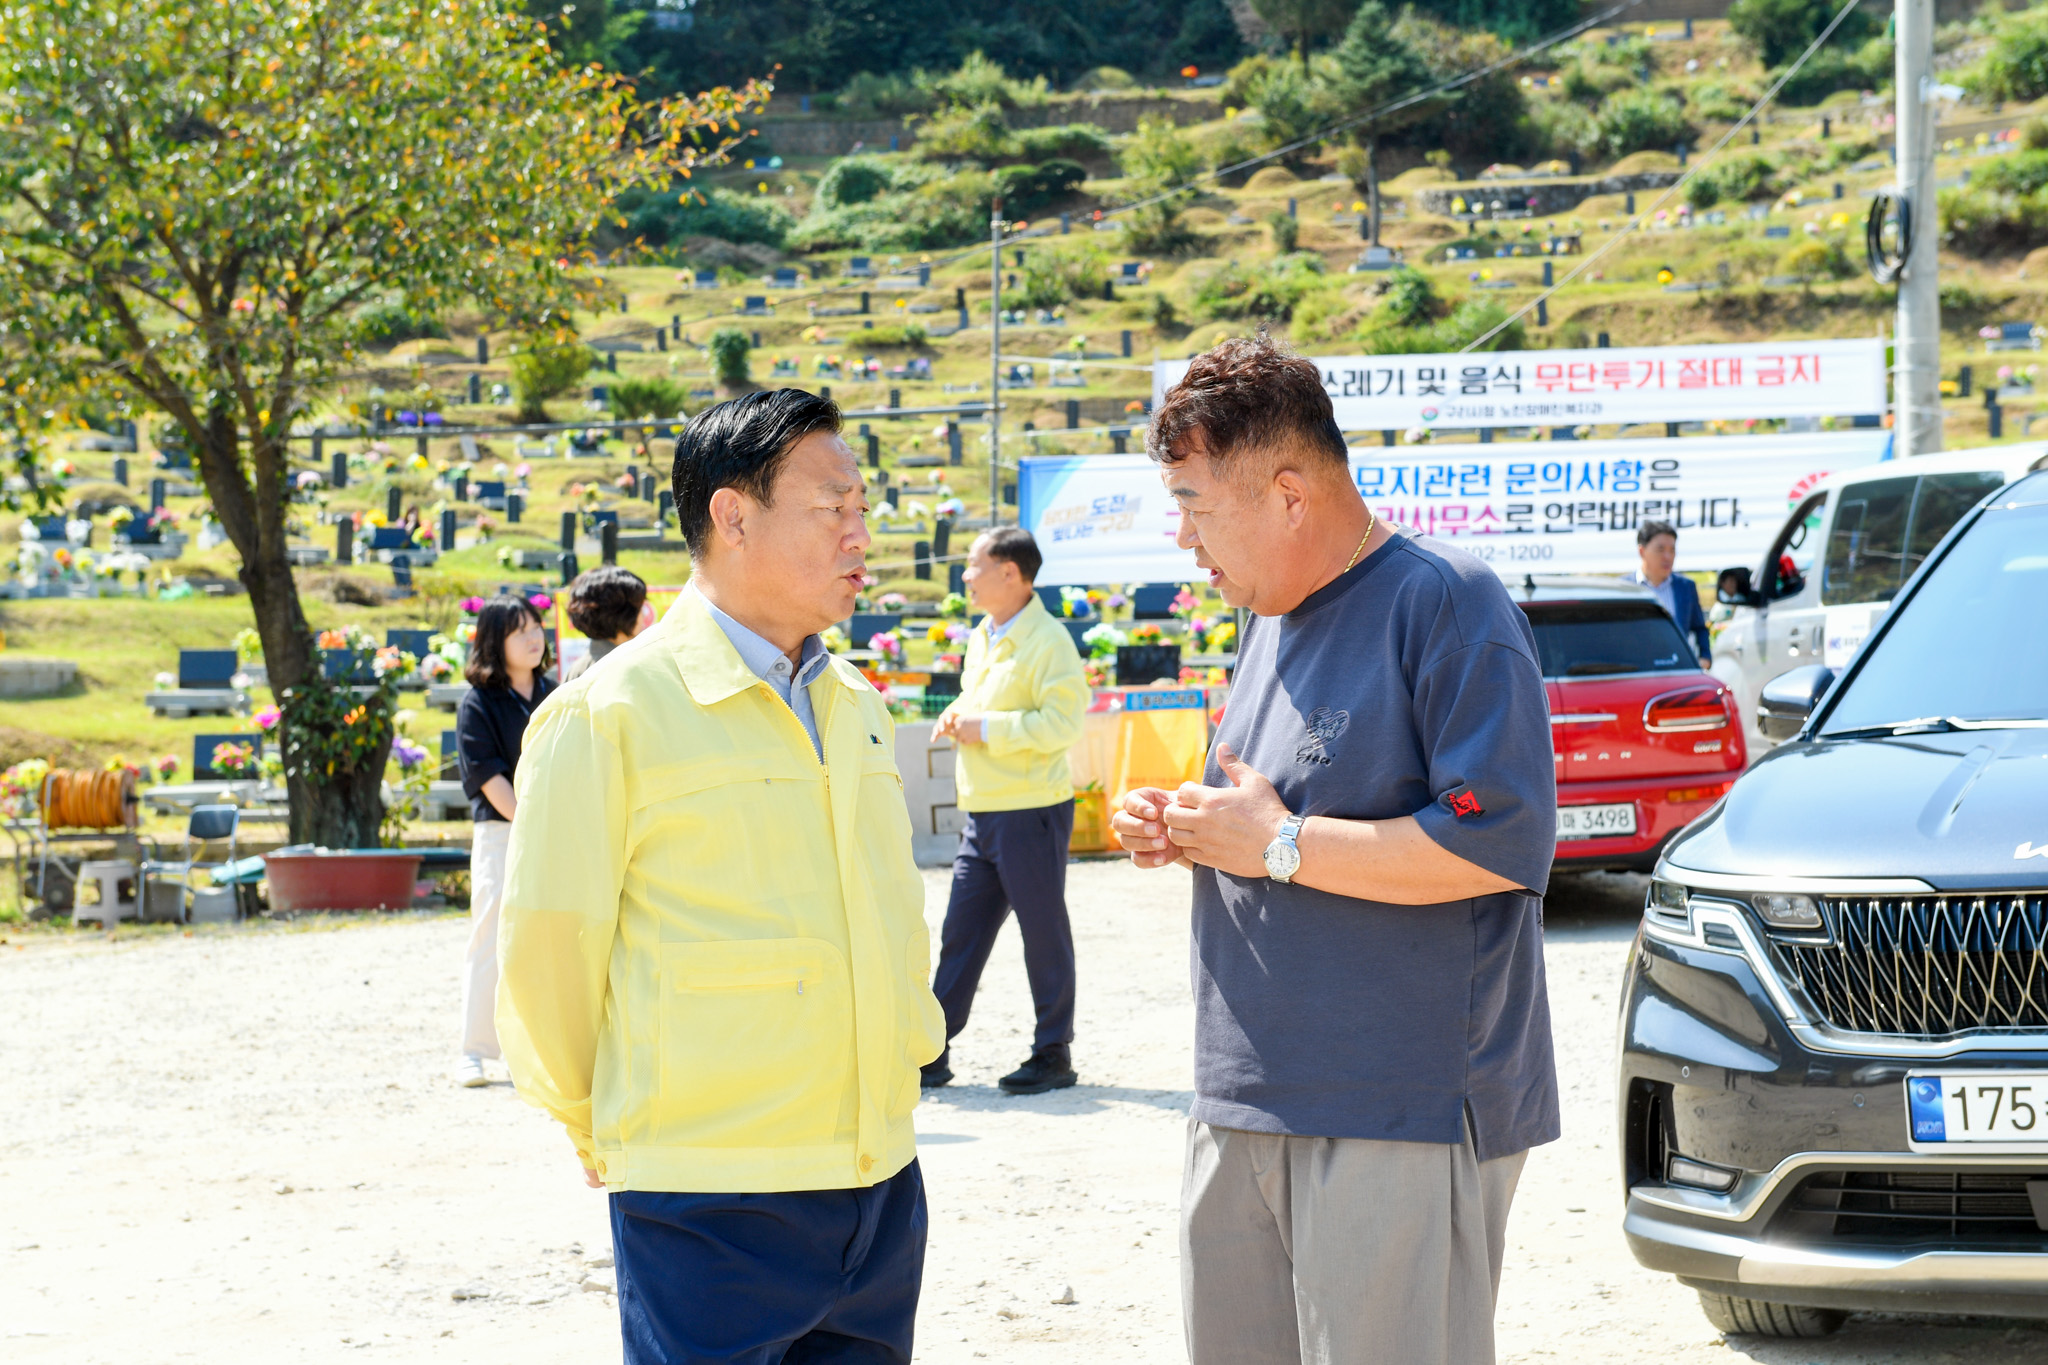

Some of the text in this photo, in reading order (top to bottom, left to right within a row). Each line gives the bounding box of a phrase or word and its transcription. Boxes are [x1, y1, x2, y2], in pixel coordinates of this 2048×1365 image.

[1417, 367, 1446, 396] 및
[1460, 365, 1521, 395] 음식
[1535, 360, 1665, 393] 무단투기
[1677, 356, 1742, 389] 절대
[1756, 354, 1820, 386] 금지
[1357, 458, 1681, 498] 묘지관련 문의사항은
[1464, 544, 1553, 562] 02-1200
[1582, 808, 1632, 832] 3498
[1951, 1087, 2036, 1130] 175
